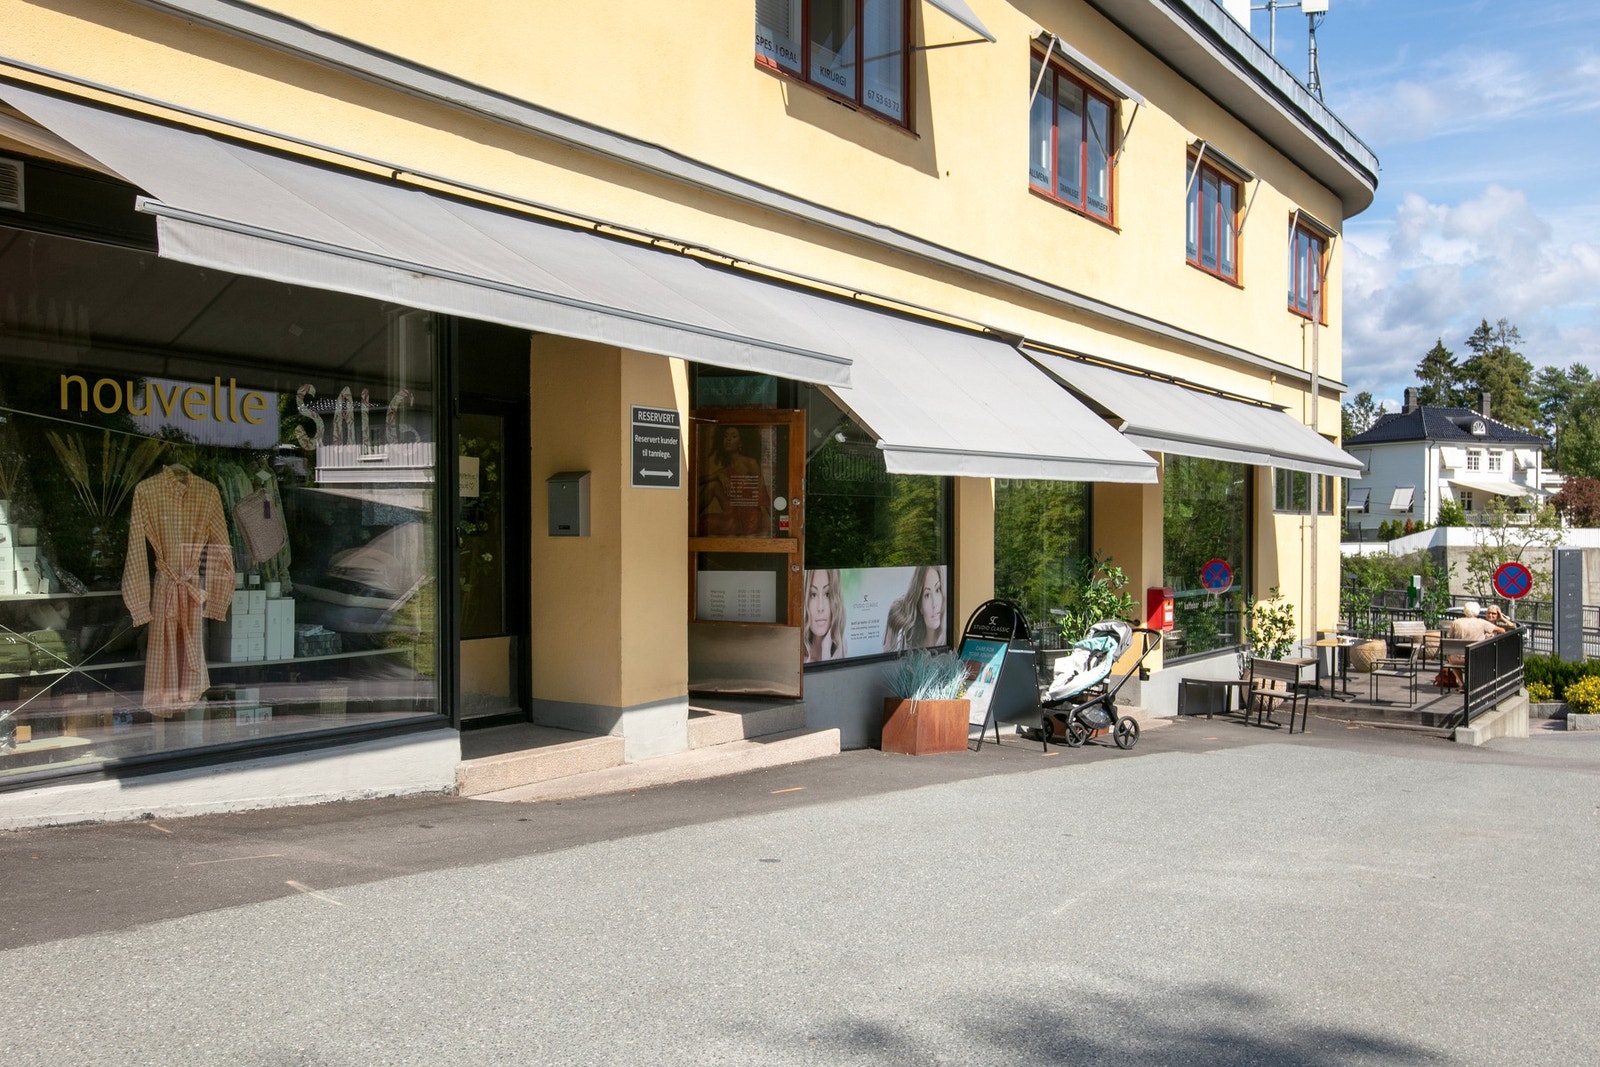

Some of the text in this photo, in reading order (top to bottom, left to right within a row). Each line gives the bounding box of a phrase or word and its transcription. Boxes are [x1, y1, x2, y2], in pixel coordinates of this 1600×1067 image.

[756, 34, 774, 52] SPES.
[779, 46, 798, 64] ORAL
[820, 66, 847, 88] KIRURGI
[867, 89, 875, 100] 67
[60, 374, 268, 425] nouvelle
[637, 410, 675, 423] RESERVERT
[634, 434, 678, 445] Reservert kunder
[648, 450, 672, 459] tannlege.
